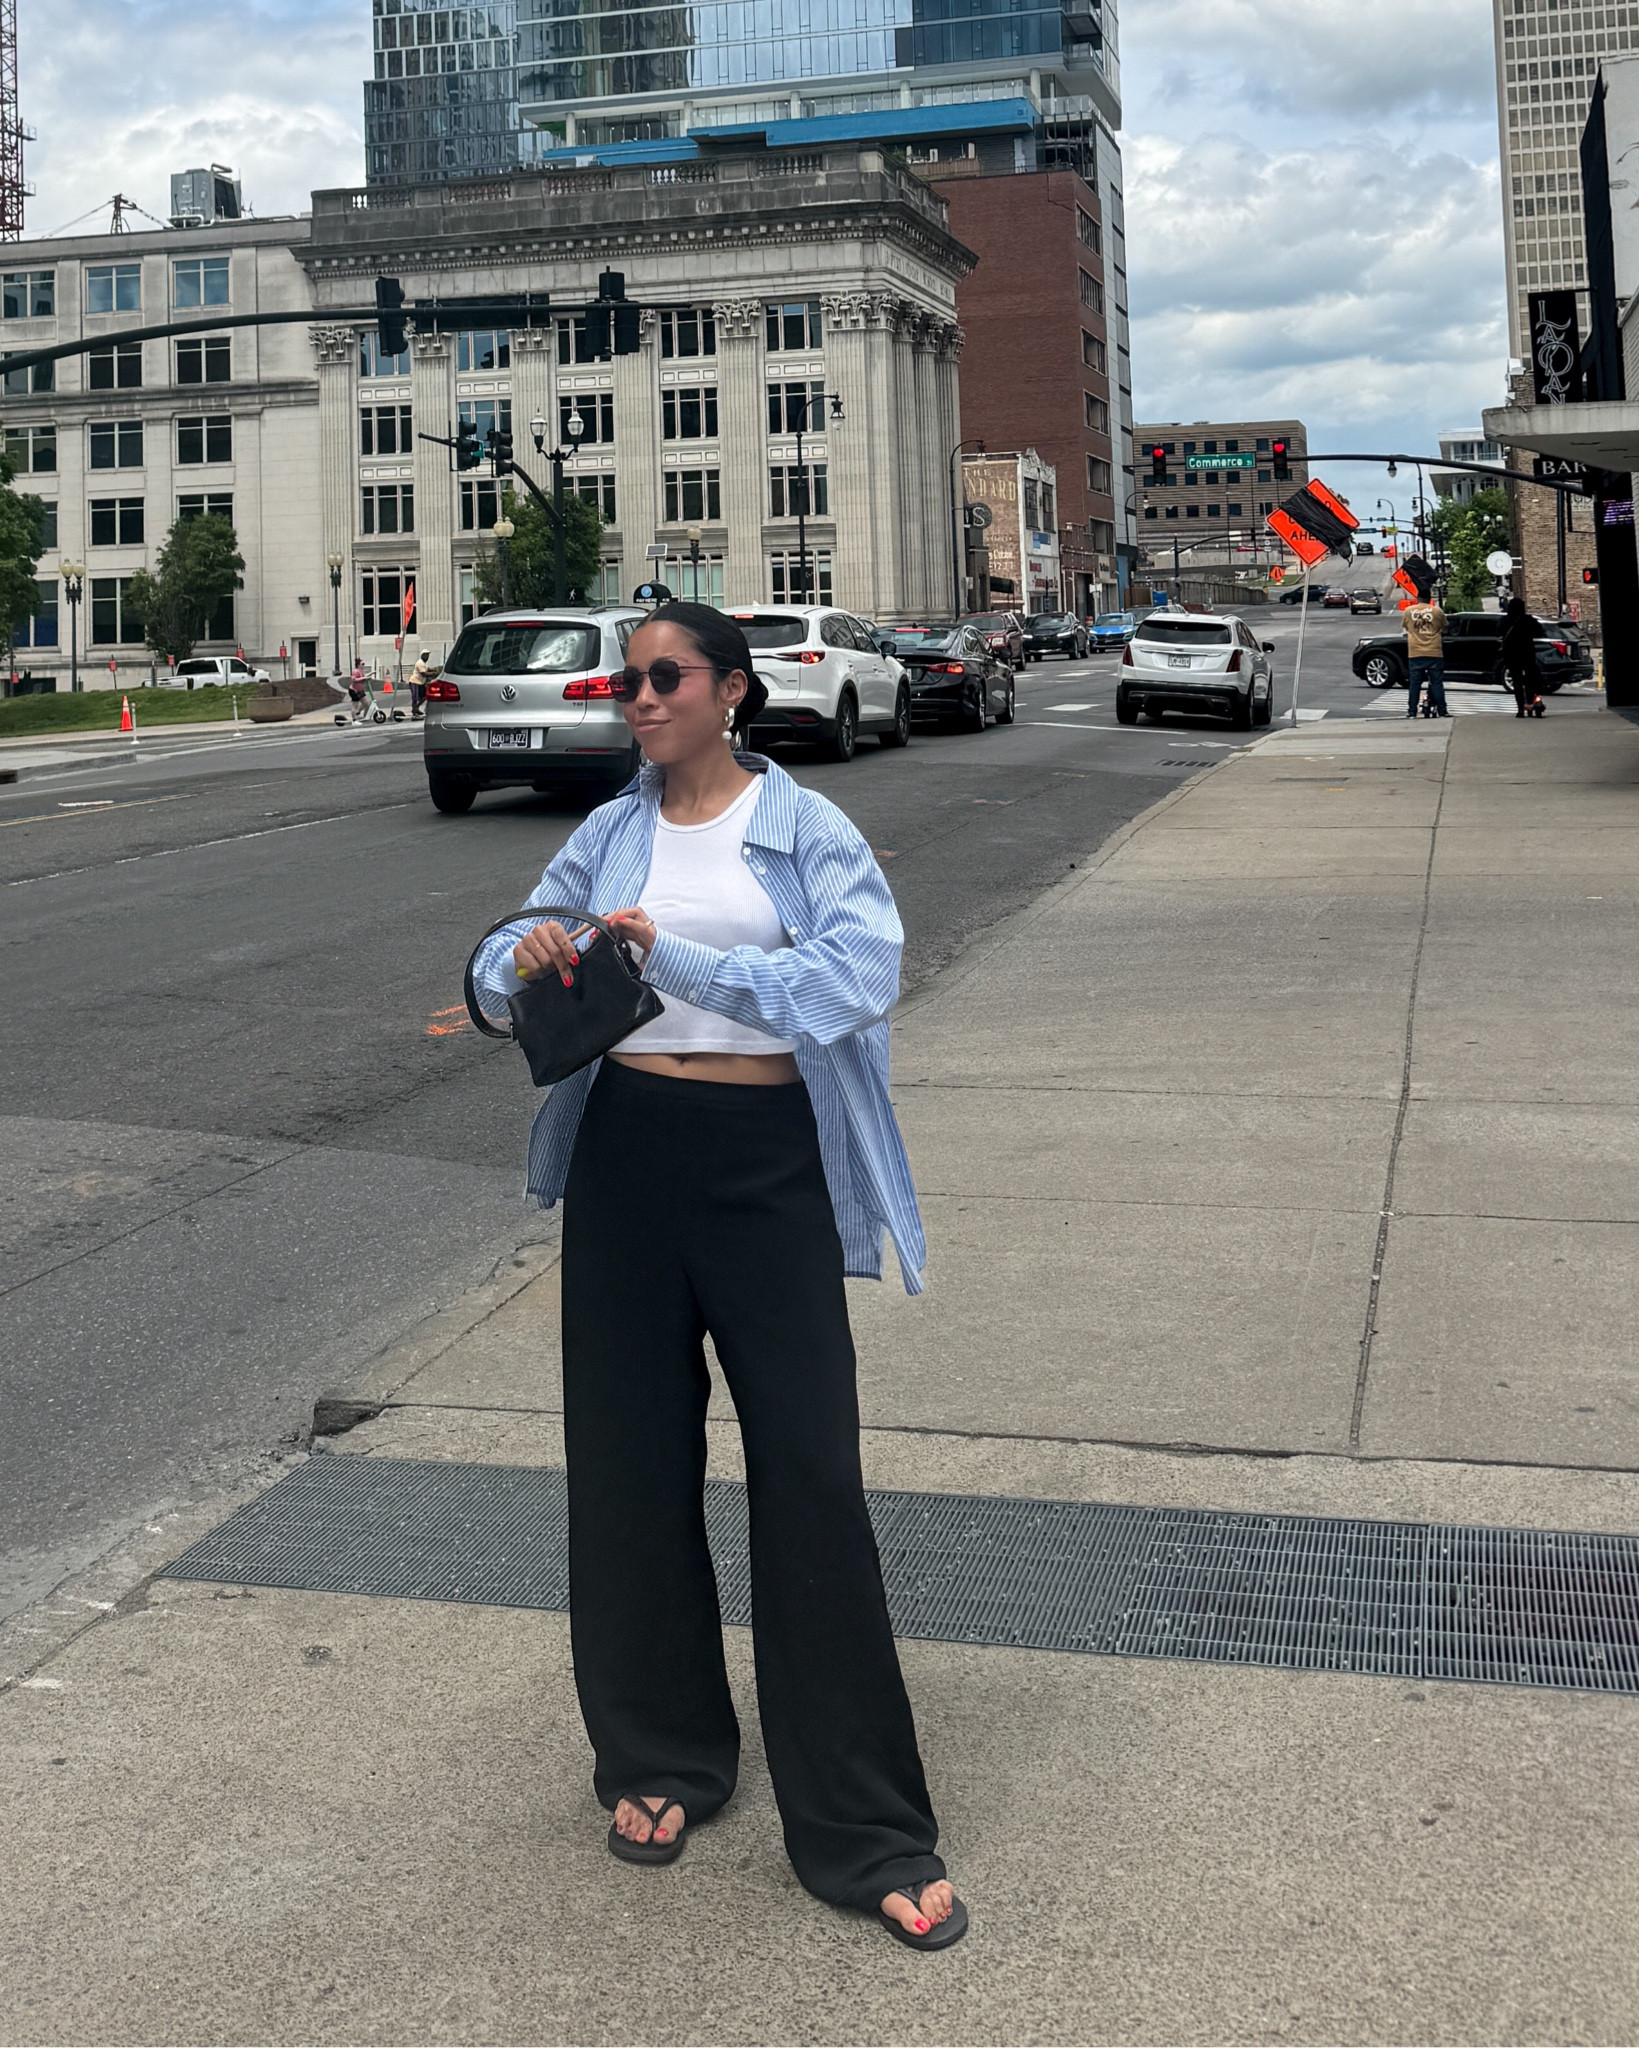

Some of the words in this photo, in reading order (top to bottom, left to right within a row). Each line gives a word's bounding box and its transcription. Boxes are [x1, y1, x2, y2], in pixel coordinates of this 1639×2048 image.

[1188, 458, 1243, 468] Commerce
[966, 477, 1016, 501] NDARD
[1290, 531, 1317, 541] AHE
[492, 733, 505, 743] 600
